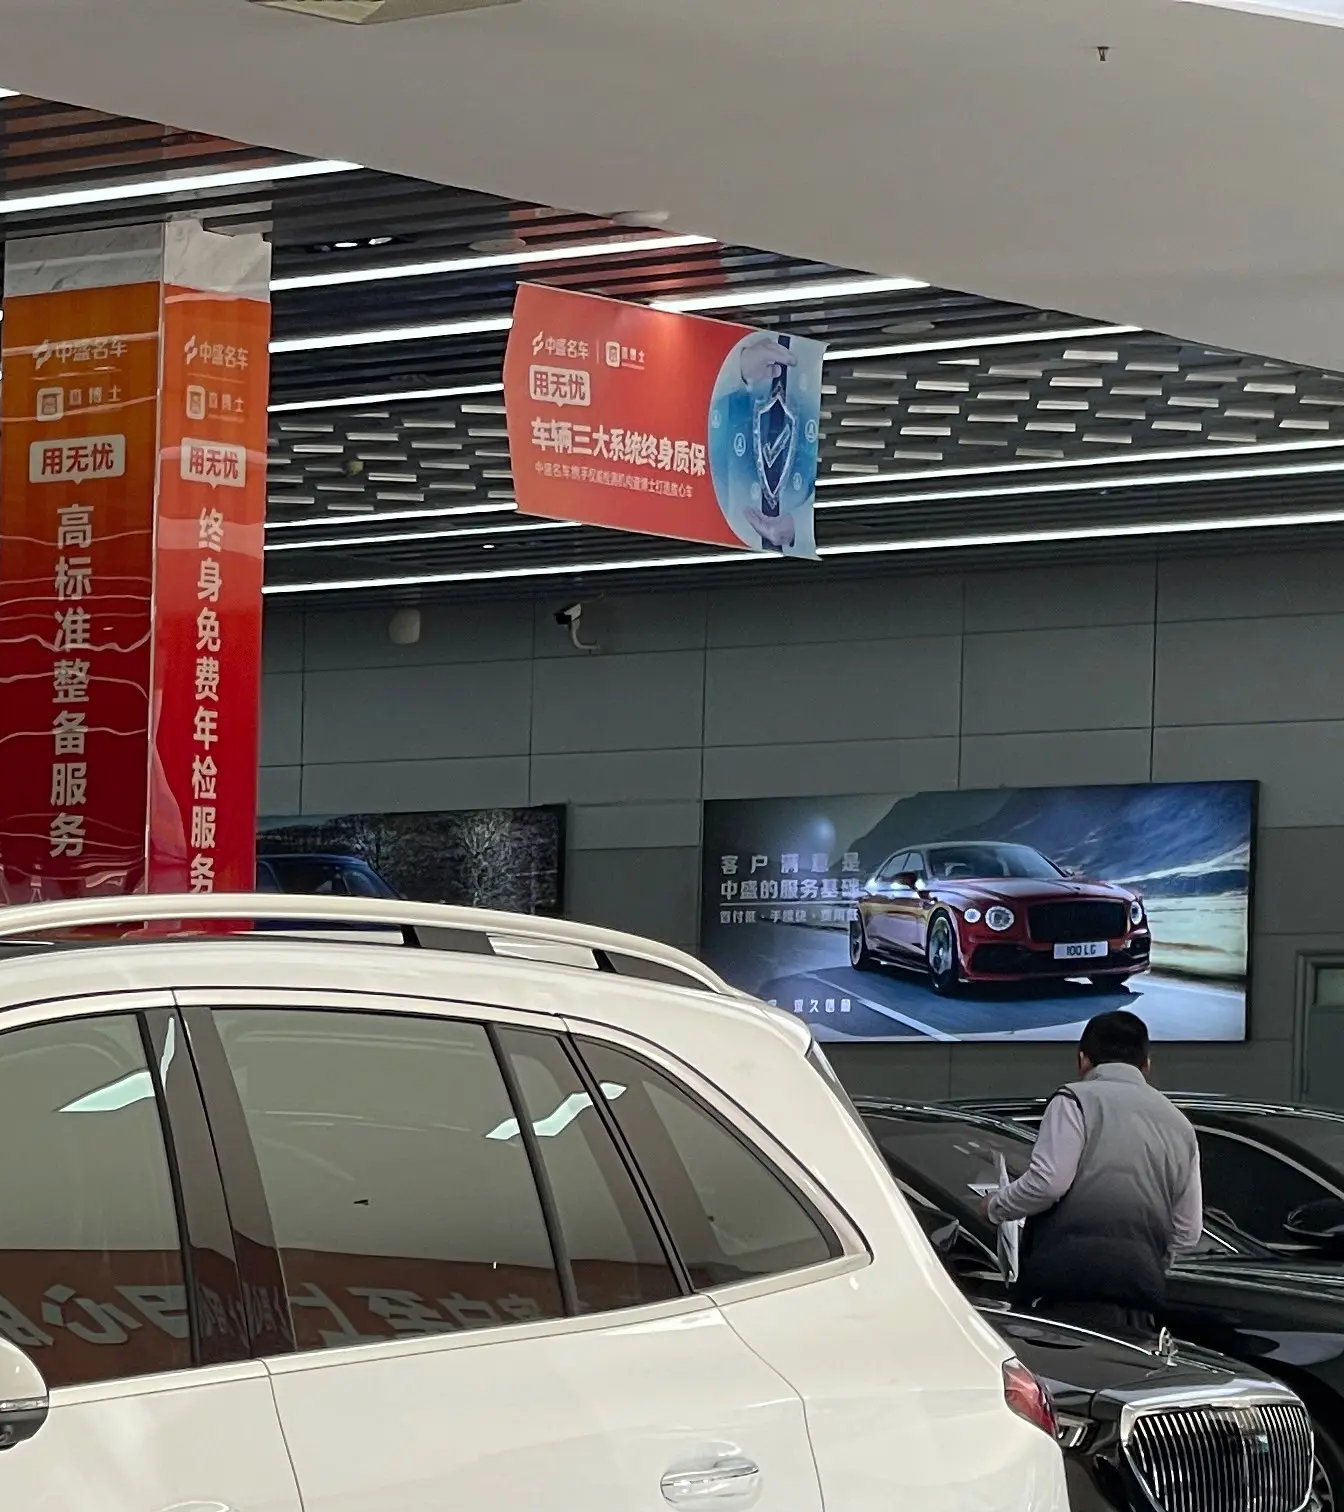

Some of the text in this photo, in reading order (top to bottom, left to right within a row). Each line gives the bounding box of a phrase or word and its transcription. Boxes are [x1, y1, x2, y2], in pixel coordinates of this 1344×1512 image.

[56, 338, 127, 364] 中盛名车
[199, 342, 248, 371] 中盛名车
[545, 338, 588, 359] 中盛名车
[534, 371, 586, 400] 用无忧
[41, 443, 114, 475] 用无忧
[531, 417, 706, 476] 车辆三大系统终身质保
[189, 445, 238, 479] 用无忧
[50, 504, 96, 857] 高标准整备服务
[190, 508, 224, 893] 终身免费年检服务
[721, 878, 861, 900] 中盛的服务基础
